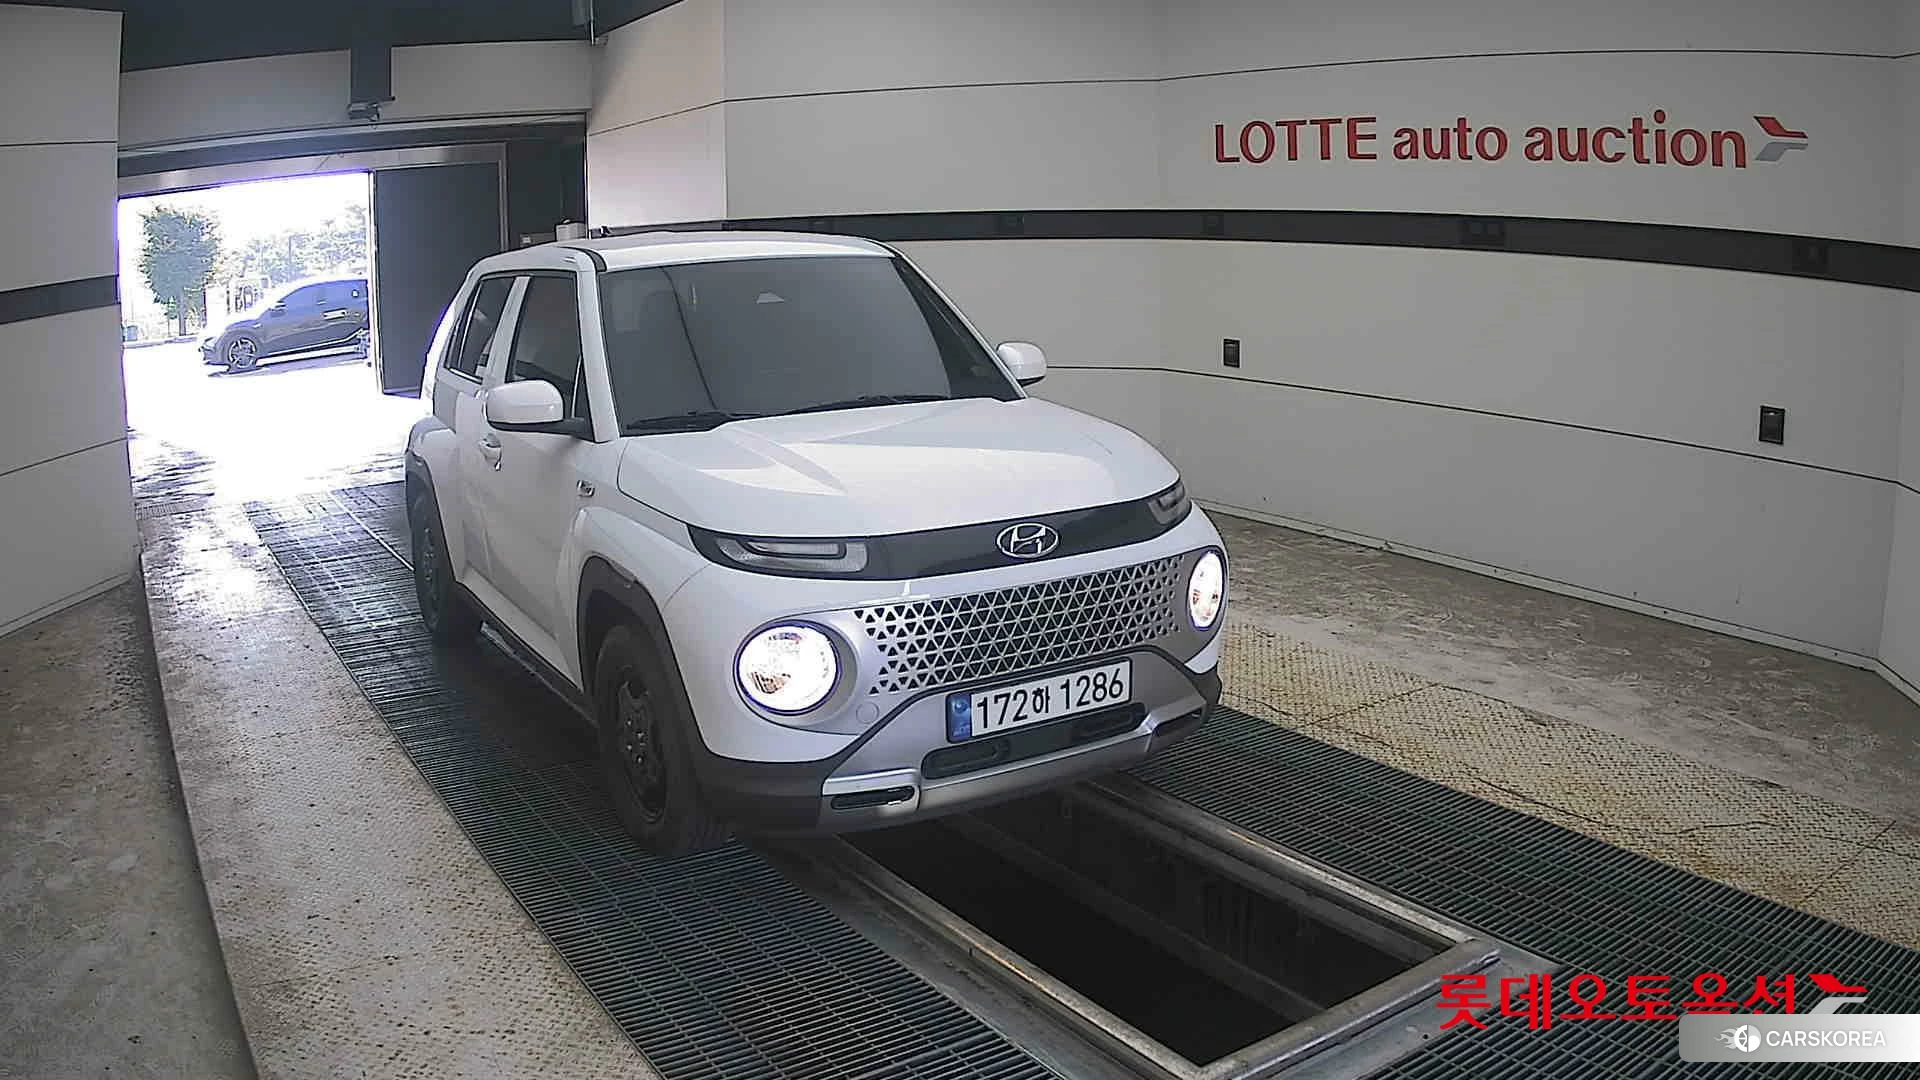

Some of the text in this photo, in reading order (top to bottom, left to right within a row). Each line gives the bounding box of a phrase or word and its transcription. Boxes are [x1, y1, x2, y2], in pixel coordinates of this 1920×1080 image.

[1215, 109, 1747, 168] LOTTE auto auction
[976, 668, 1124, 729] 172하 1286
